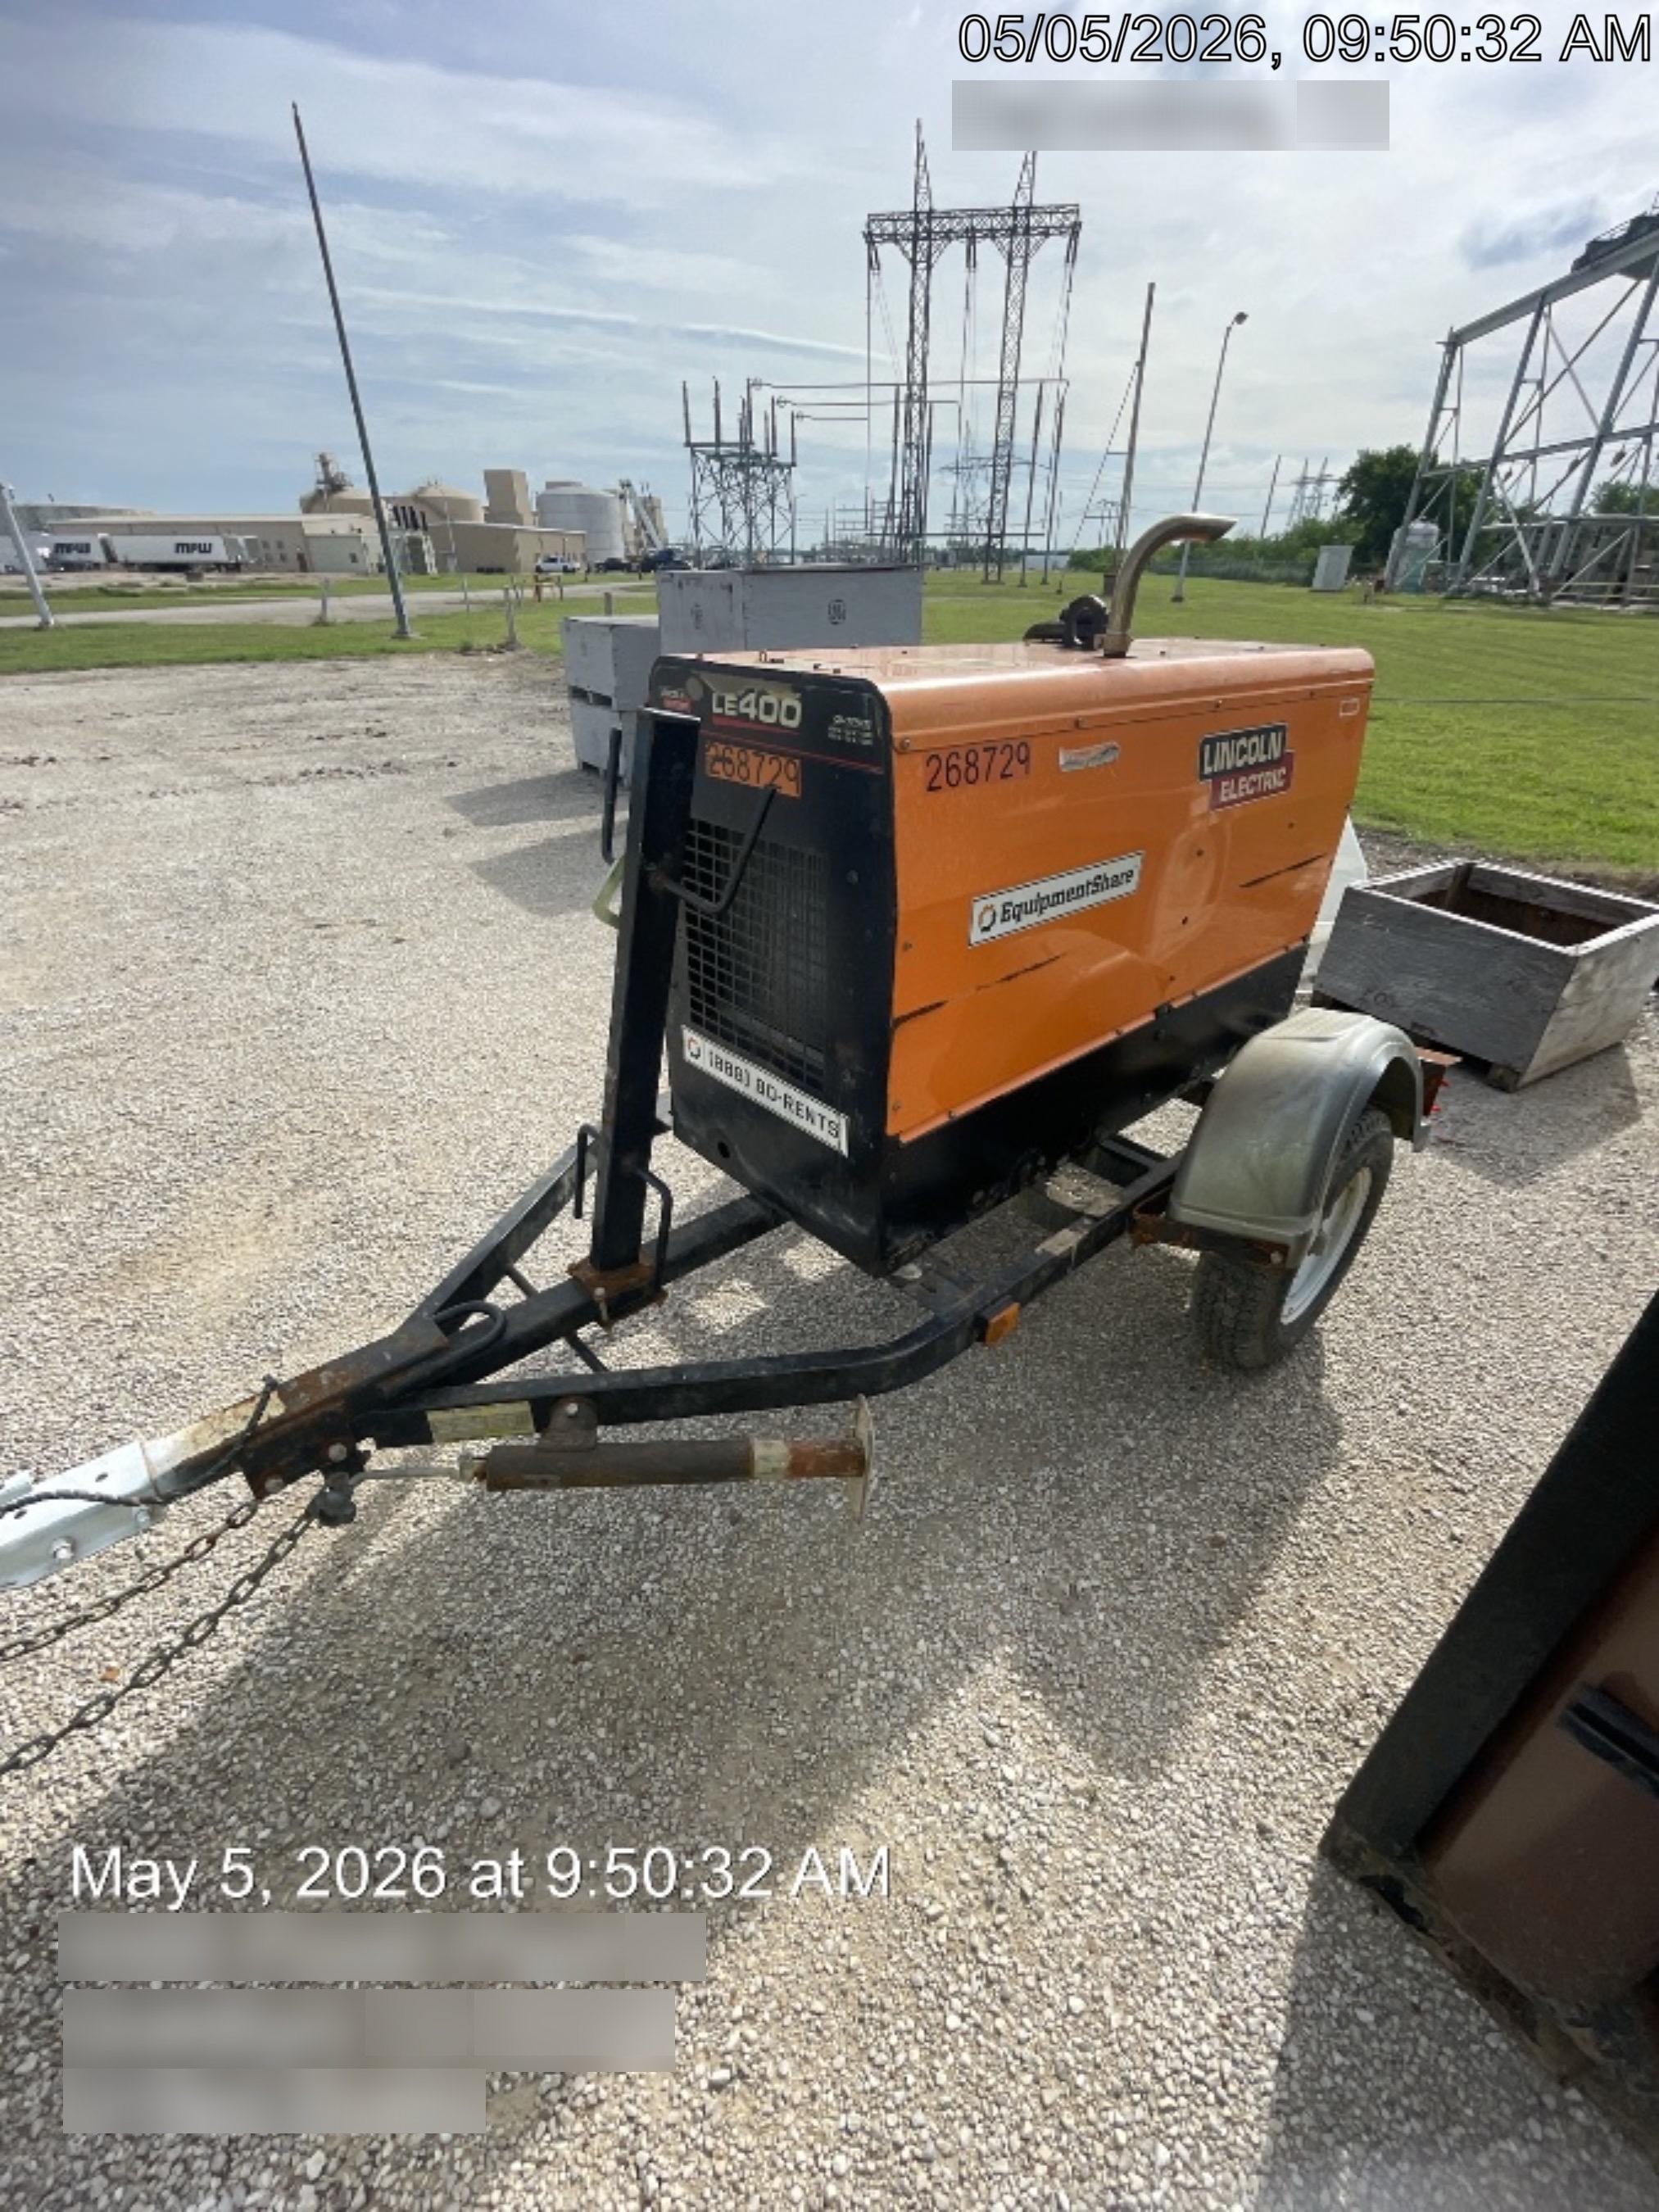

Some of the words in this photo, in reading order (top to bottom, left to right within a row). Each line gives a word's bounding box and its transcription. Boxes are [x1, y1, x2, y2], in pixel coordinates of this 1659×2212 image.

[712, 687, 803, 729] LE400
[708, 741, 801, 798] 268729
[925, 741, 1032, 792] 268729
[1203, 731, 1284, 774] LINCOLN
[1219, 766, 1287, 803] ELECTRIC
[999, 868, 1135, 924] EquipmentShare
